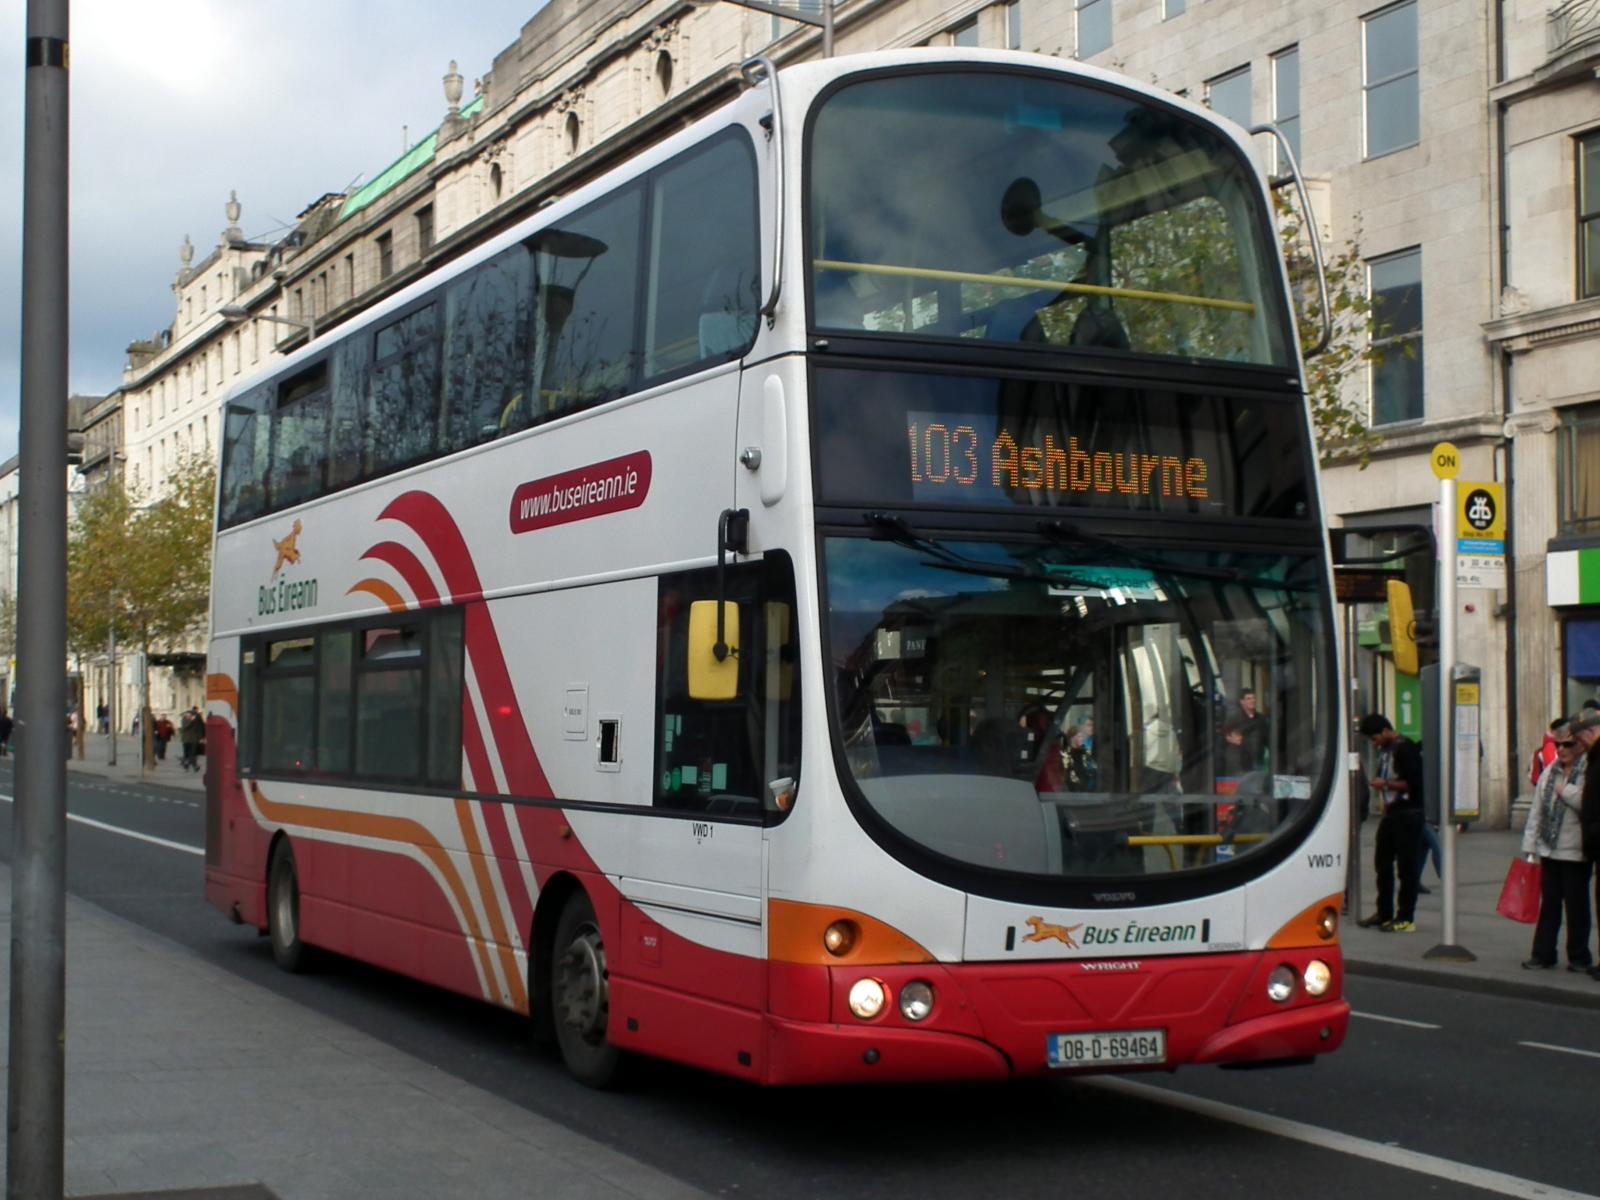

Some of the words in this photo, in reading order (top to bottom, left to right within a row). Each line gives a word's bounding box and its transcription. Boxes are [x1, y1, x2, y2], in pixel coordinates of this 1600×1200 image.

[908, 422, 977, 485] 103
[992, 428, 1208, 498] Ashbourne
[1437, 455, 1455, 467] ON
[520, 466, 637, 520] www.buseireann.ie
[259, 585, 276, 616] Bus
[692, 823, 708, 837] VWD
[1308, 854, 1334, 868] VWD
[1082, 926, 1120, 944] Bus
[1081, 961, 1142, 970] WRIGHT
[1064, 1036, 1158, 1060] 08-D-69464
